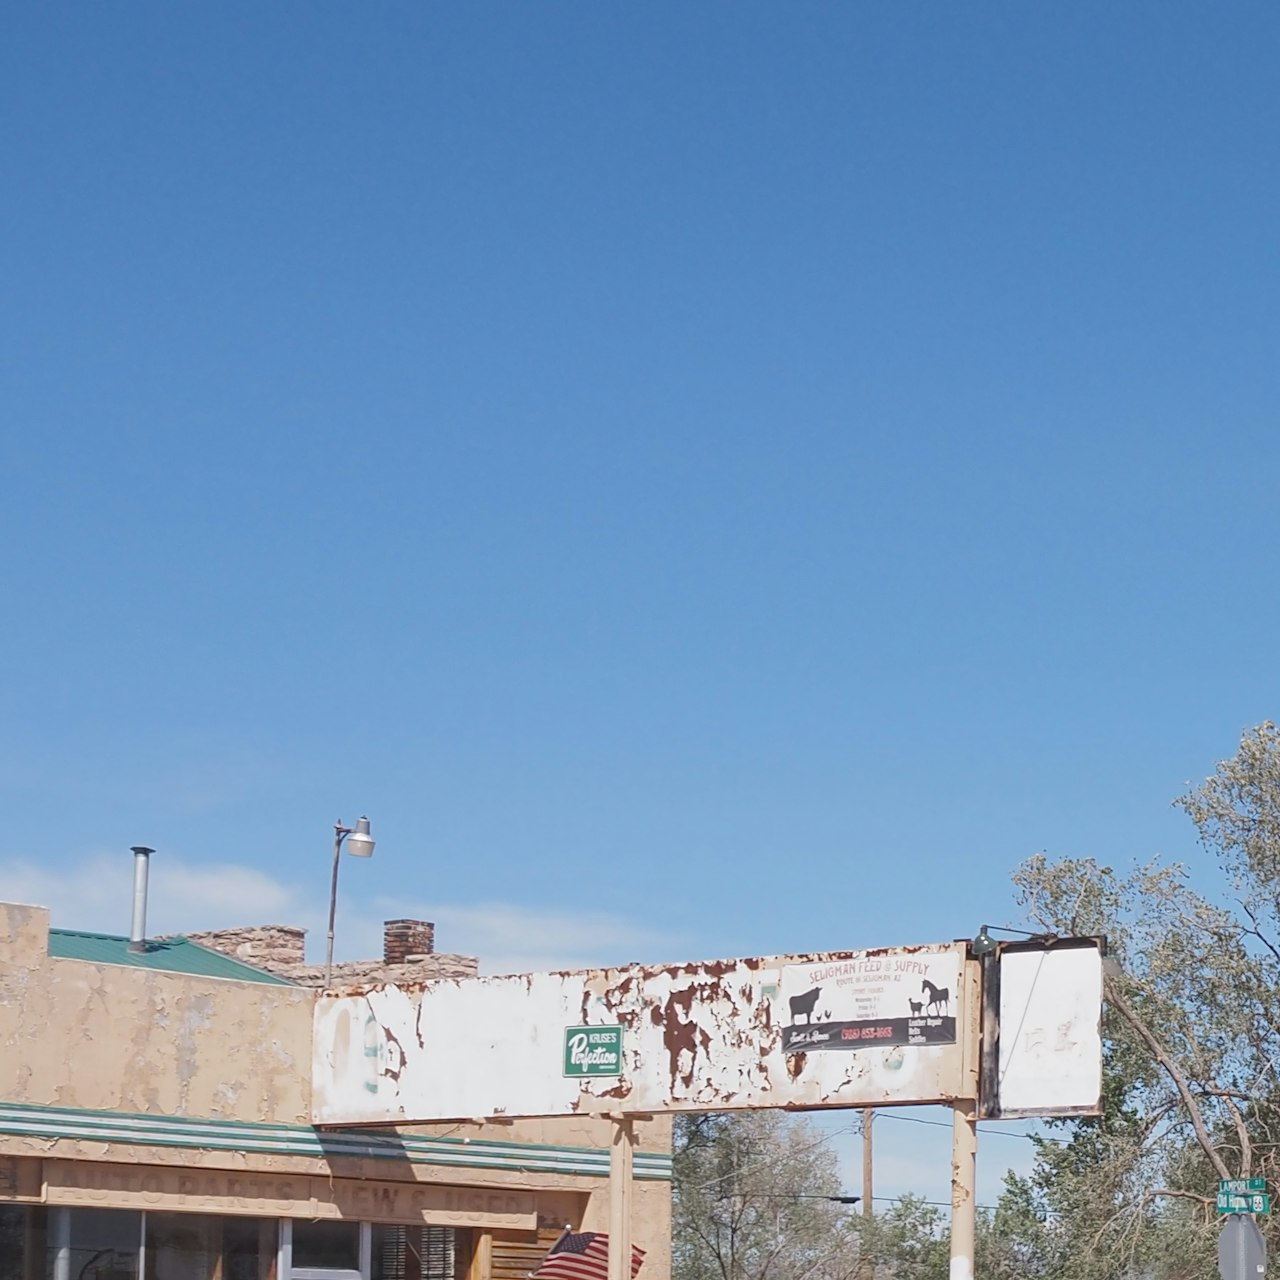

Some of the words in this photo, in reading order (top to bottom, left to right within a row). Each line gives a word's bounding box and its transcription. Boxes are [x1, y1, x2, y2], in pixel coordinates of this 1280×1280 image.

[809, 963, 855, 985] SELIGMAN
[859, 960, 882, 973] FEED
[894, 961, 930, 976] SUPPLY
[568, 1034, 617, 1072] Perfection
[178, 1175, 295, 1210] PARTS
[1220, 1180, 1250, 1192] LAMPORT
